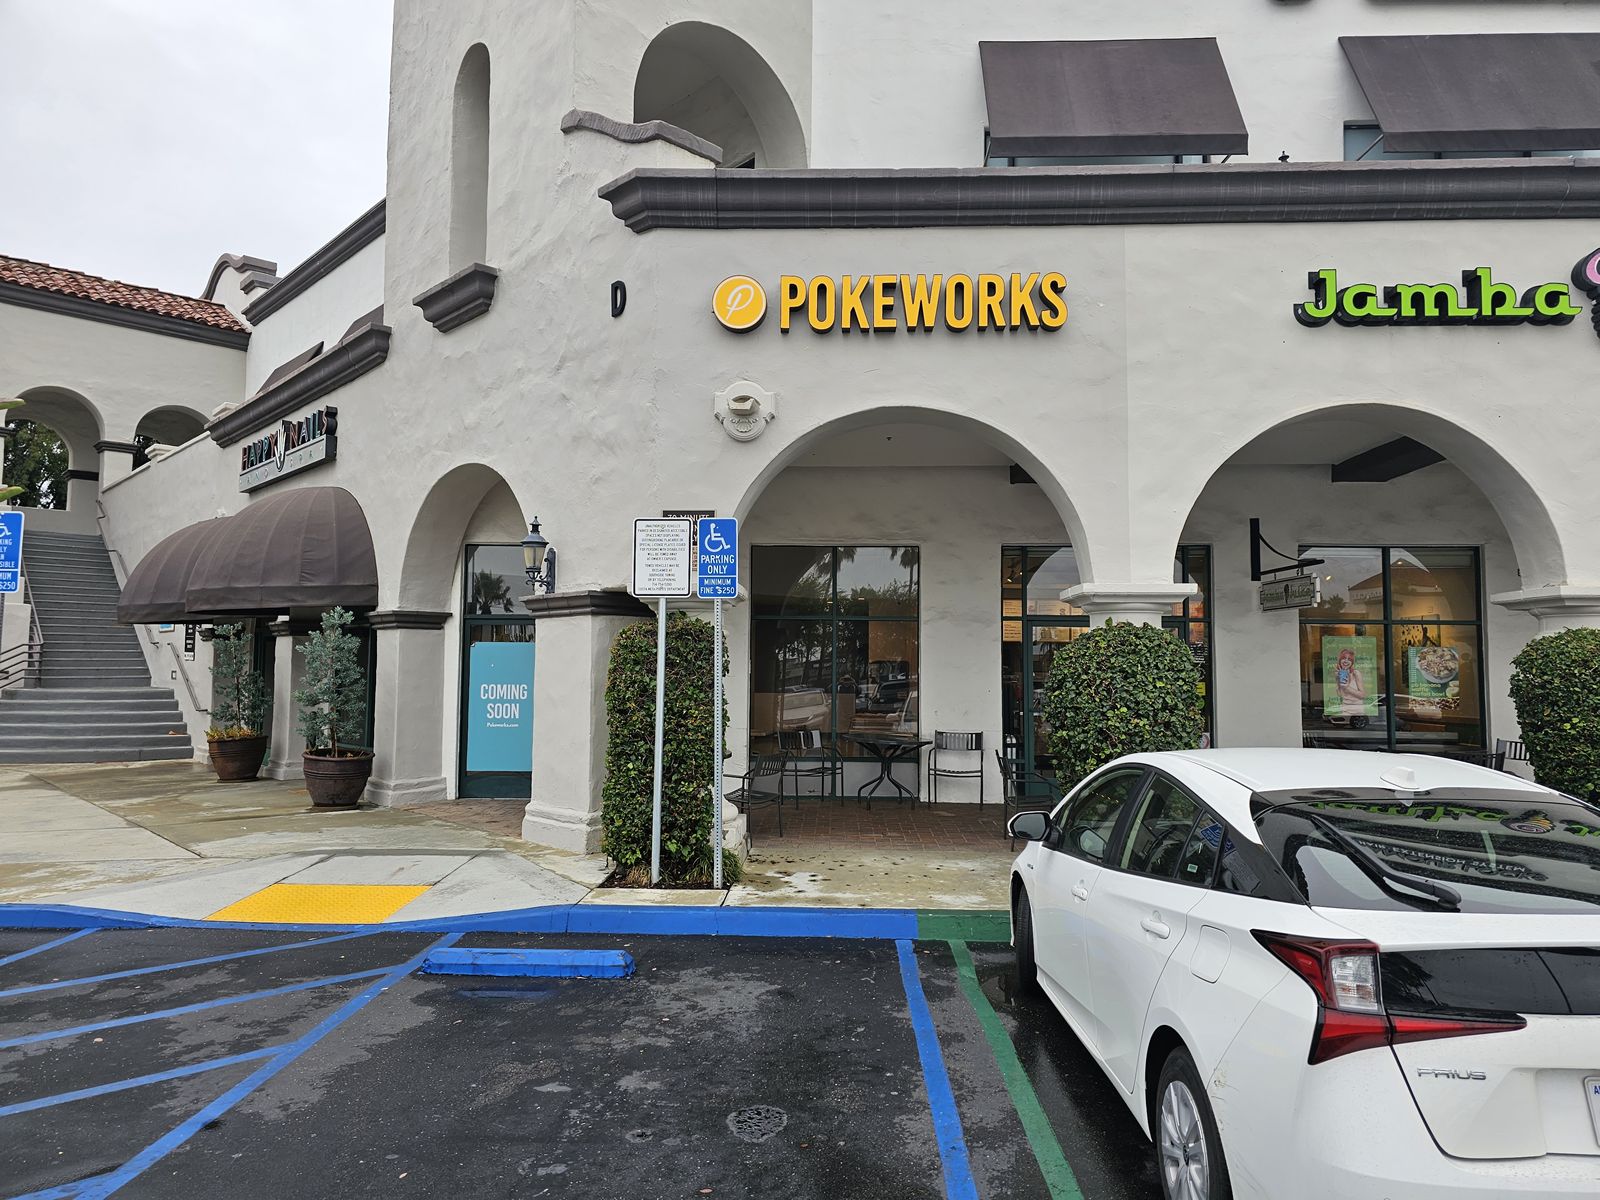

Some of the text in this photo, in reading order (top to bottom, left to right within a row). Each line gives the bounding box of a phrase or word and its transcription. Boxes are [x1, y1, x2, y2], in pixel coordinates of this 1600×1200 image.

[610, 280, 627, 318] D
[779, 272, 1069, 334] POKEWORKS
[1294, 266, 1583, 327] Jamba
[241, 405, 338, 472] HAPPY NAILS
[700, 555, 735, 564] PARKING
[707, 564, 728, 574] ONLY
[700, 586, 714, 594] FINE
[704, 578, 732, 586] MINIMUM
[480, 683, 528, 700] COMING
[486, 703, 520, 719] SOON
[1416, 1067, 1487, 1081] PRIUS
